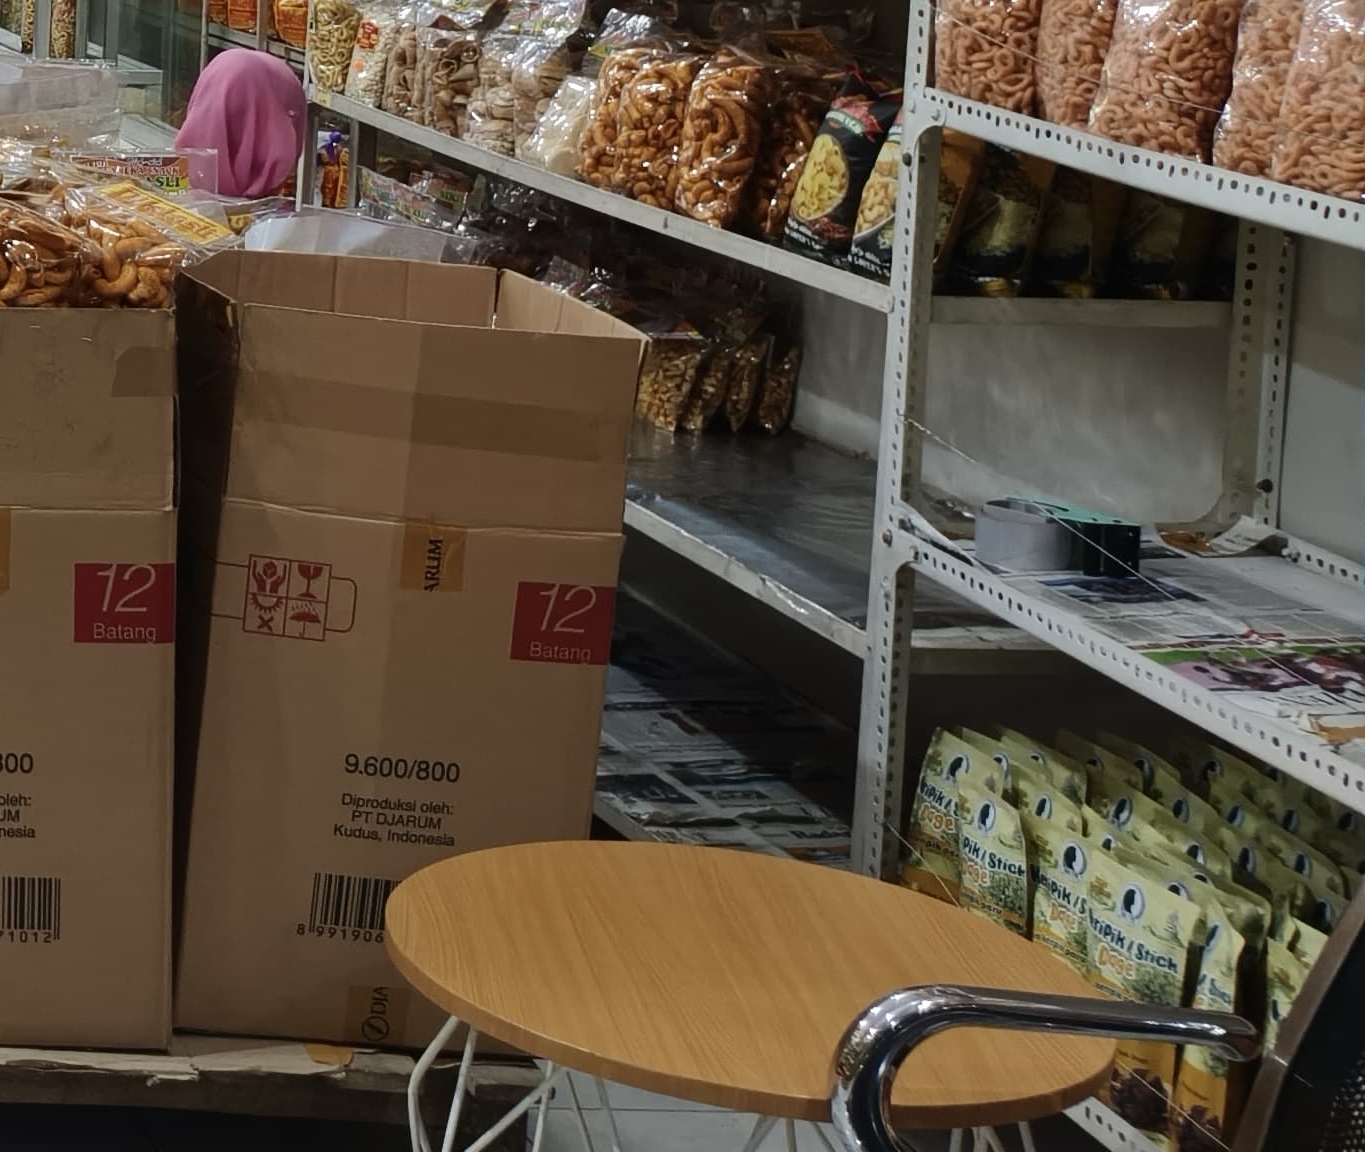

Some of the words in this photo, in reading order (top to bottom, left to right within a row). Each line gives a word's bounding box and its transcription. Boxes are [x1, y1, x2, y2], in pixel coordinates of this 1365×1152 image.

[98, 563, 156, 614] 12
[537, 583, 597, 634] 12
[92, 622, 157, 644] Batang
[529, 640, 592, 663] Batang
[344, 752, 461, 784] 9.600/800
[341, 792, 417, 815] Diproduksi
[419, 799, 454, 816] oleh:
[351, 811, 372, 826] PT
[376, 812, 441, 830] DJARUM
[333, 824, 382, 843] Kudus,
[387, 829, 455, 848] Indonesia
[986, 853, 1026, 879] Stick
[1097, 944, 1136, 979] Dage
[1134, 942, 1179, 976] Stick
